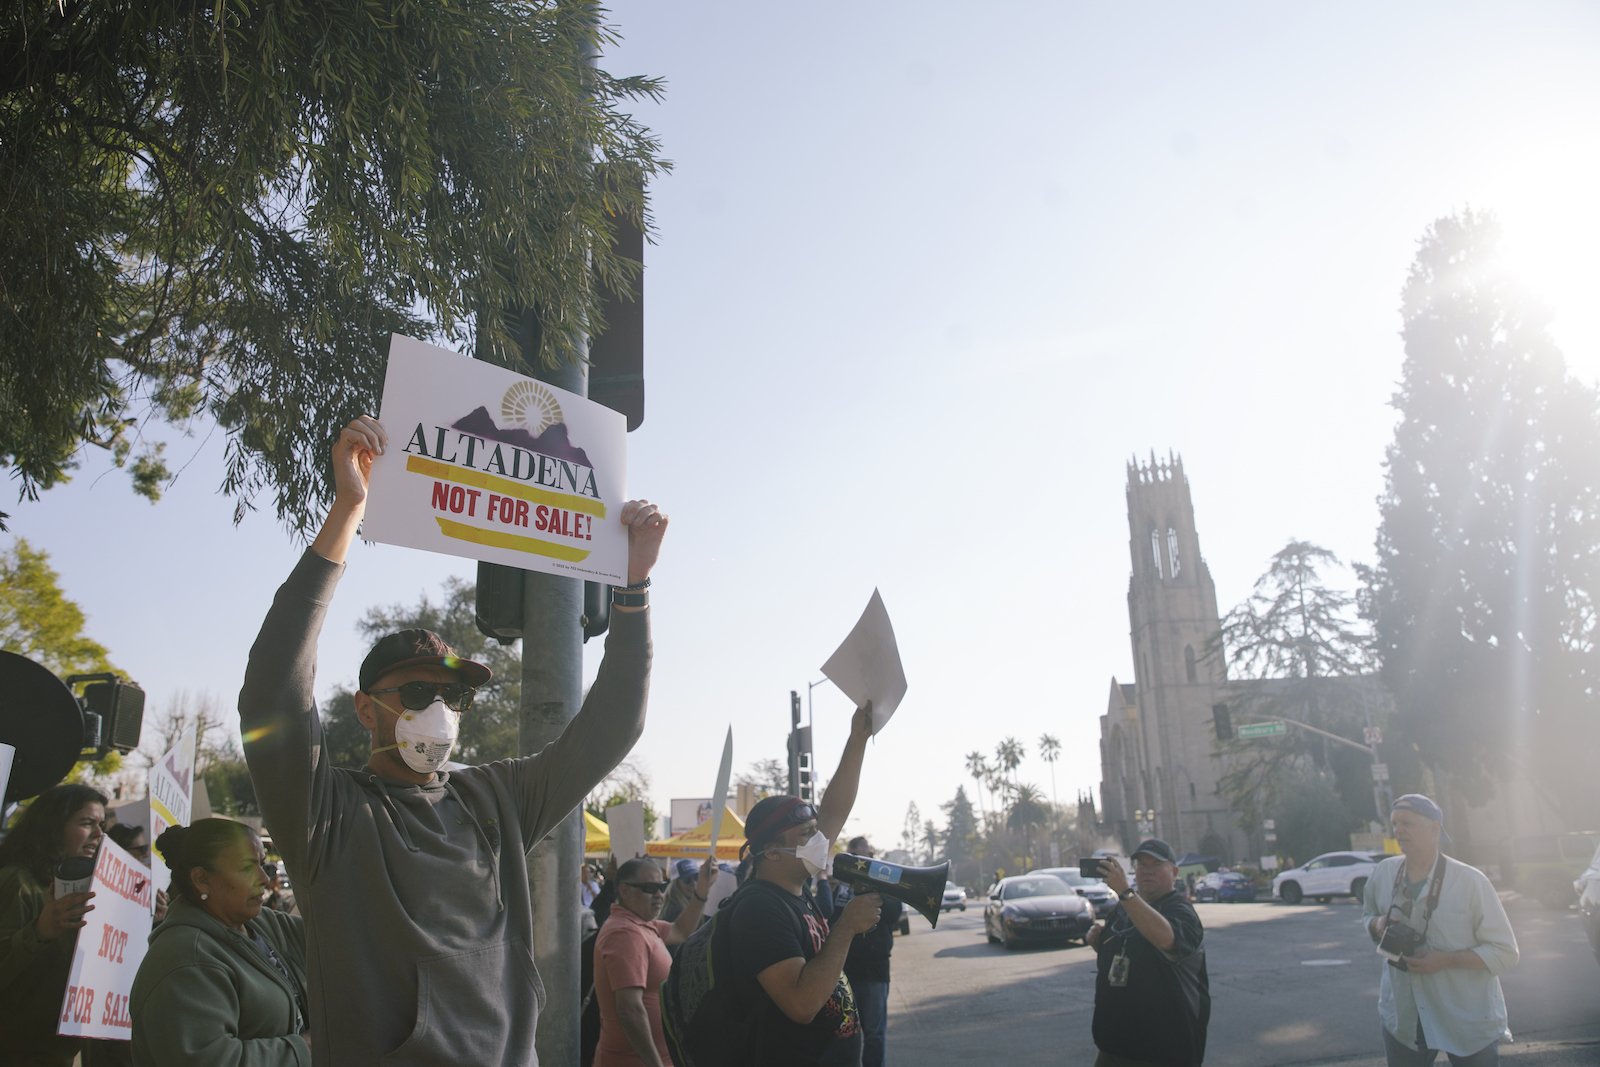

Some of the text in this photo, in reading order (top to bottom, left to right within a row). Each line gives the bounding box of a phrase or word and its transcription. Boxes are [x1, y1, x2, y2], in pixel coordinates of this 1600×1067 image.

[402, 422, 601, 499] ALTADENA
[432, 481, 592, 541] NOT FOR SALE!
[98, 923, 128, 964] NOT
[63, 985, 132, 1028] FOR SAL
